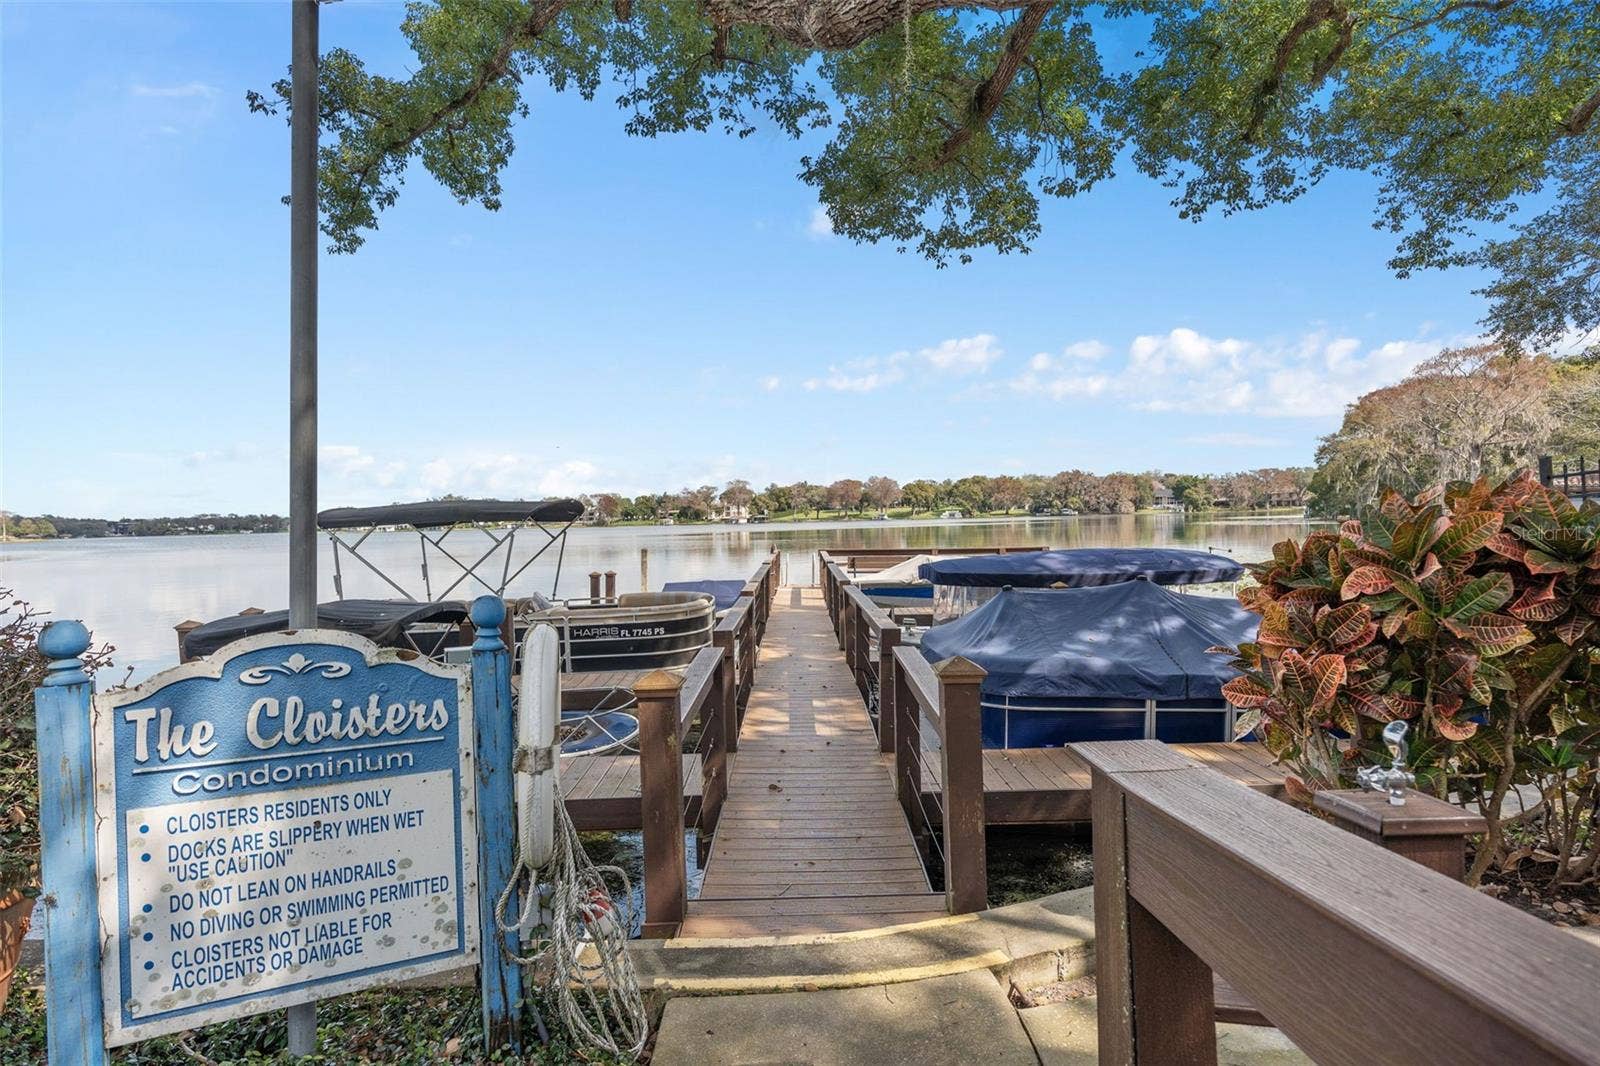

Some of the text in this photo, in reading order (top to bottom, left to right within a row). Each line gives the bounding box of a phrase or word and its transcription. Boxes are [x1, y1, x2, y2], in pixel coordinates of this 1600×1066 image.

[574, 627, 619, 637] HARRIS
[621, 629, 631, 637] FL
[632, 628, 652, 637] 7745
[654, 627, 665, 635] PS
[125, 693, 449, 762] The Cloisters
[172, 751, 413, 794] Condominium
[167, 788, 392, 834] CLOISTERS RESIDENTS ONLY
[168, 809, 424, 863] DOCKS ARE SLIPPERY WHEN WET
[168, 848, 293, 882] "USE CAUTION"
[170, 859, 396, 913] DO NOT LEAN ON HANDRAILS
[170, 875, 449, 942] NO DIVING OR SWIMMING PERMITTED
[172, 912, 392, 969] CLOISTERS NOT LIABLE FOR
[172, 937, 363, 991] ACCIDENTS OR DAMAGE
